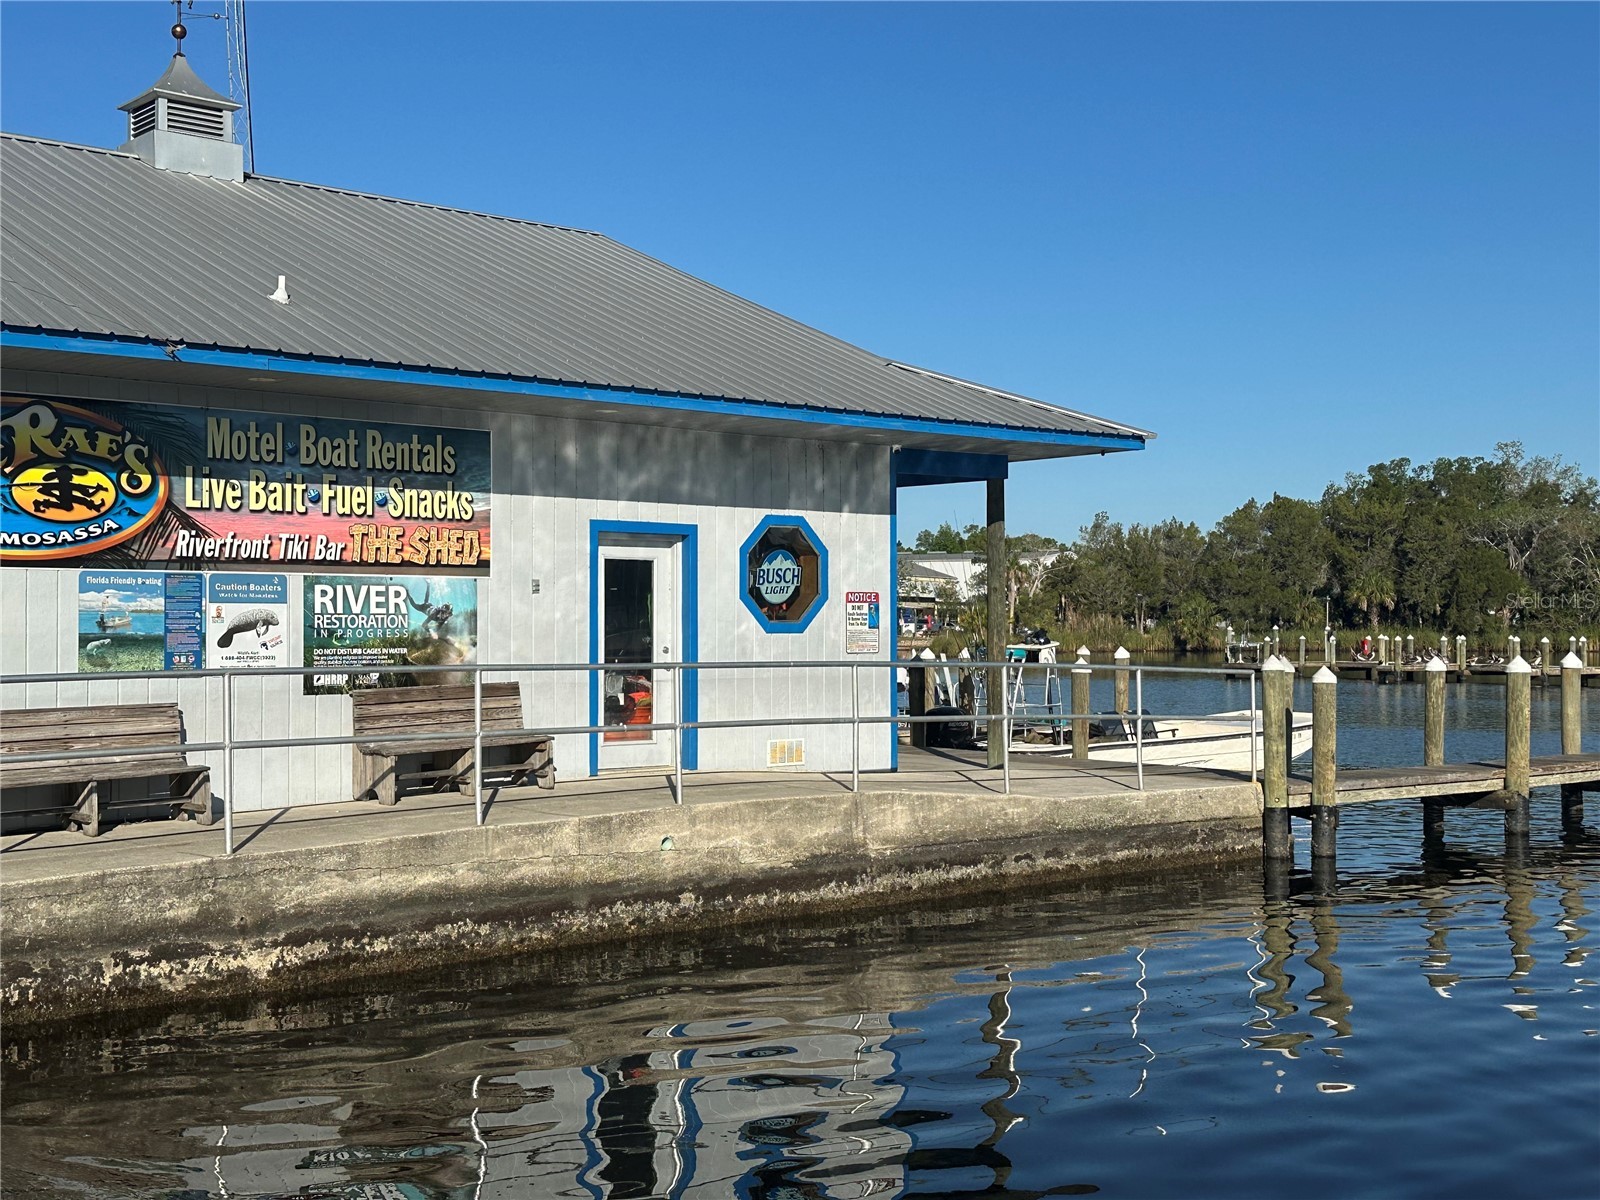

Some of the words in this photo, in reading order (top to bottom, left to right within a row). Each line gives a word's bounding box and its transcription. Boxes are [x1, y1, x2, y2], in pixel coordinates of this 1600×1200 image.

[207, 416, 283, 463] Motel
[299, 423, 359, 468] Boat
[366, 429, 456, 474] Rentals
[185, 465, 242, 510] Live
[249, 469, 307, 513] Bait
[322, 473, 373, 516] Fuel
[387, 477, 474, 521] Snacks
[175, 529, 272, 558] Riverfront
[278, 533, 310, 560] Tiki
[314, 534, 346, 561] Bar
[349, 523, 404, 564] THE
[409, 526, 481, 566] SHED
[86, 576, 109, 585] Florida
[110, 576, 136, 586] Friendly
[137, 577, 162, 586] Boating
[757, 567, 801, 586] BUSCH
[215, 583, 248, 591] Caution
[249, 583, 282, 592] Boaters
[764, 586, 791, 595] LIGHT
[314, 584, 408, 614] RIVER
[848, 592, 877, 602] NOTICE
[314, 614, 408, 629] RESTORATION
[314, 629, 328, 638] IN
[337, 629, 409, 638] PROGRESS
[324, 673, 349, 685] HRRP
